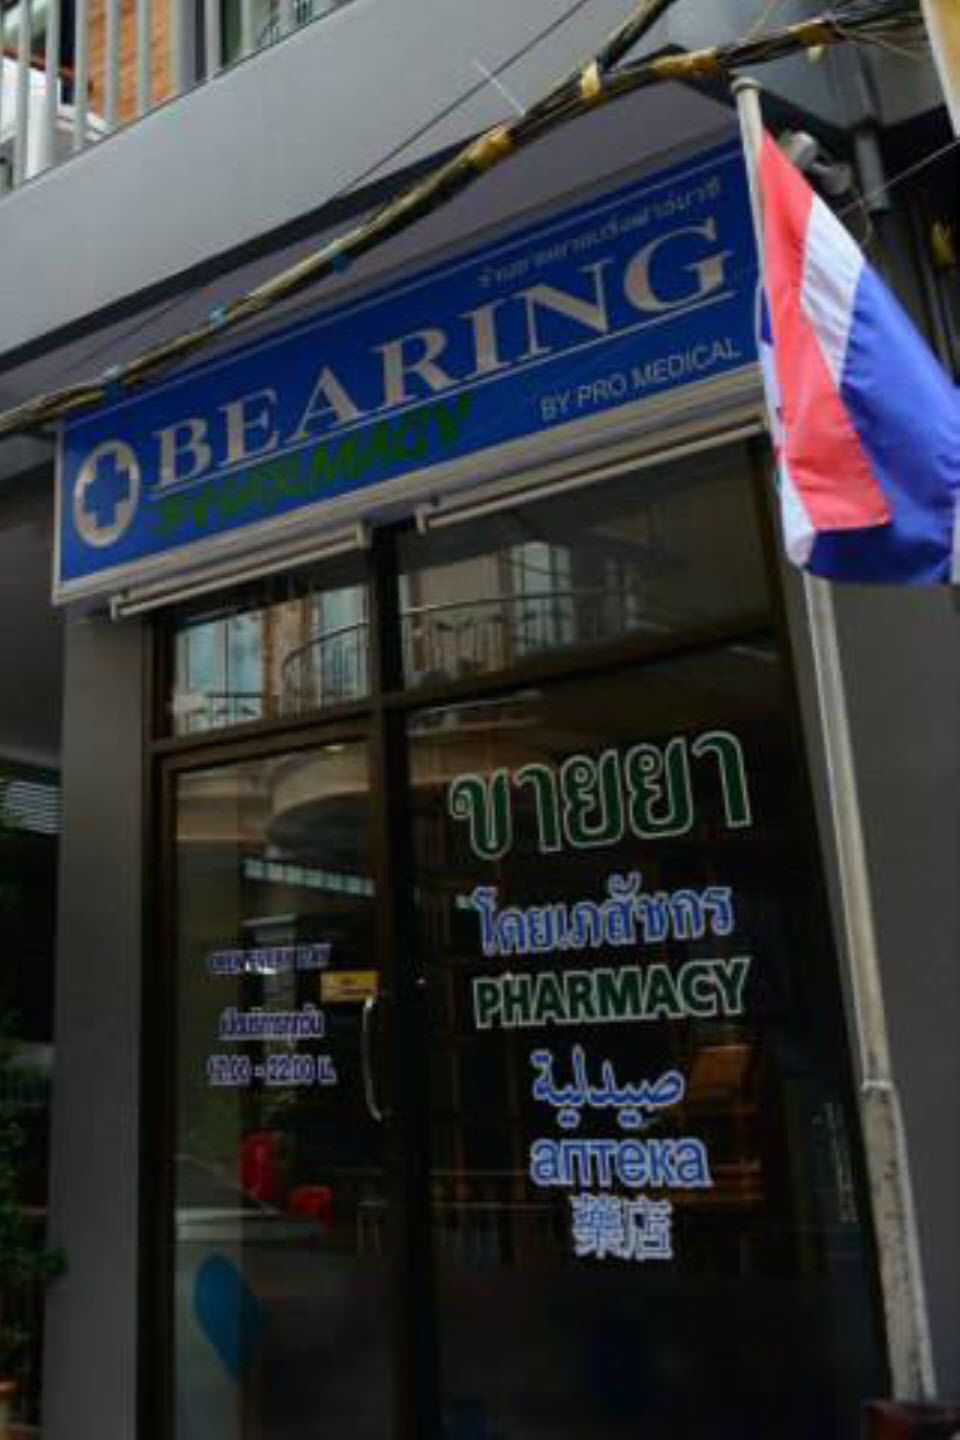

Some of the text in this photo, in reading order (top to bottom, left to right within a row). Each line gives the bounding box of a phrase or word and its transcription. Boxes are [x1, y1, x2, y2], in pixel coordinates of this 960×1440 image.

[151, 215, 733, 491] BEARING
[541, 337, 741, 421] BY PRO MEDICAL
[449, 729, 753, 859] ขายยา
[471, 871, 733, 957] โดยเภสัชกร
[475, 956, 753, 1029] PHARMACY
[530, 1044, 685, 1130] صيدلية
[529, 1136, 713, 1190] аптека
